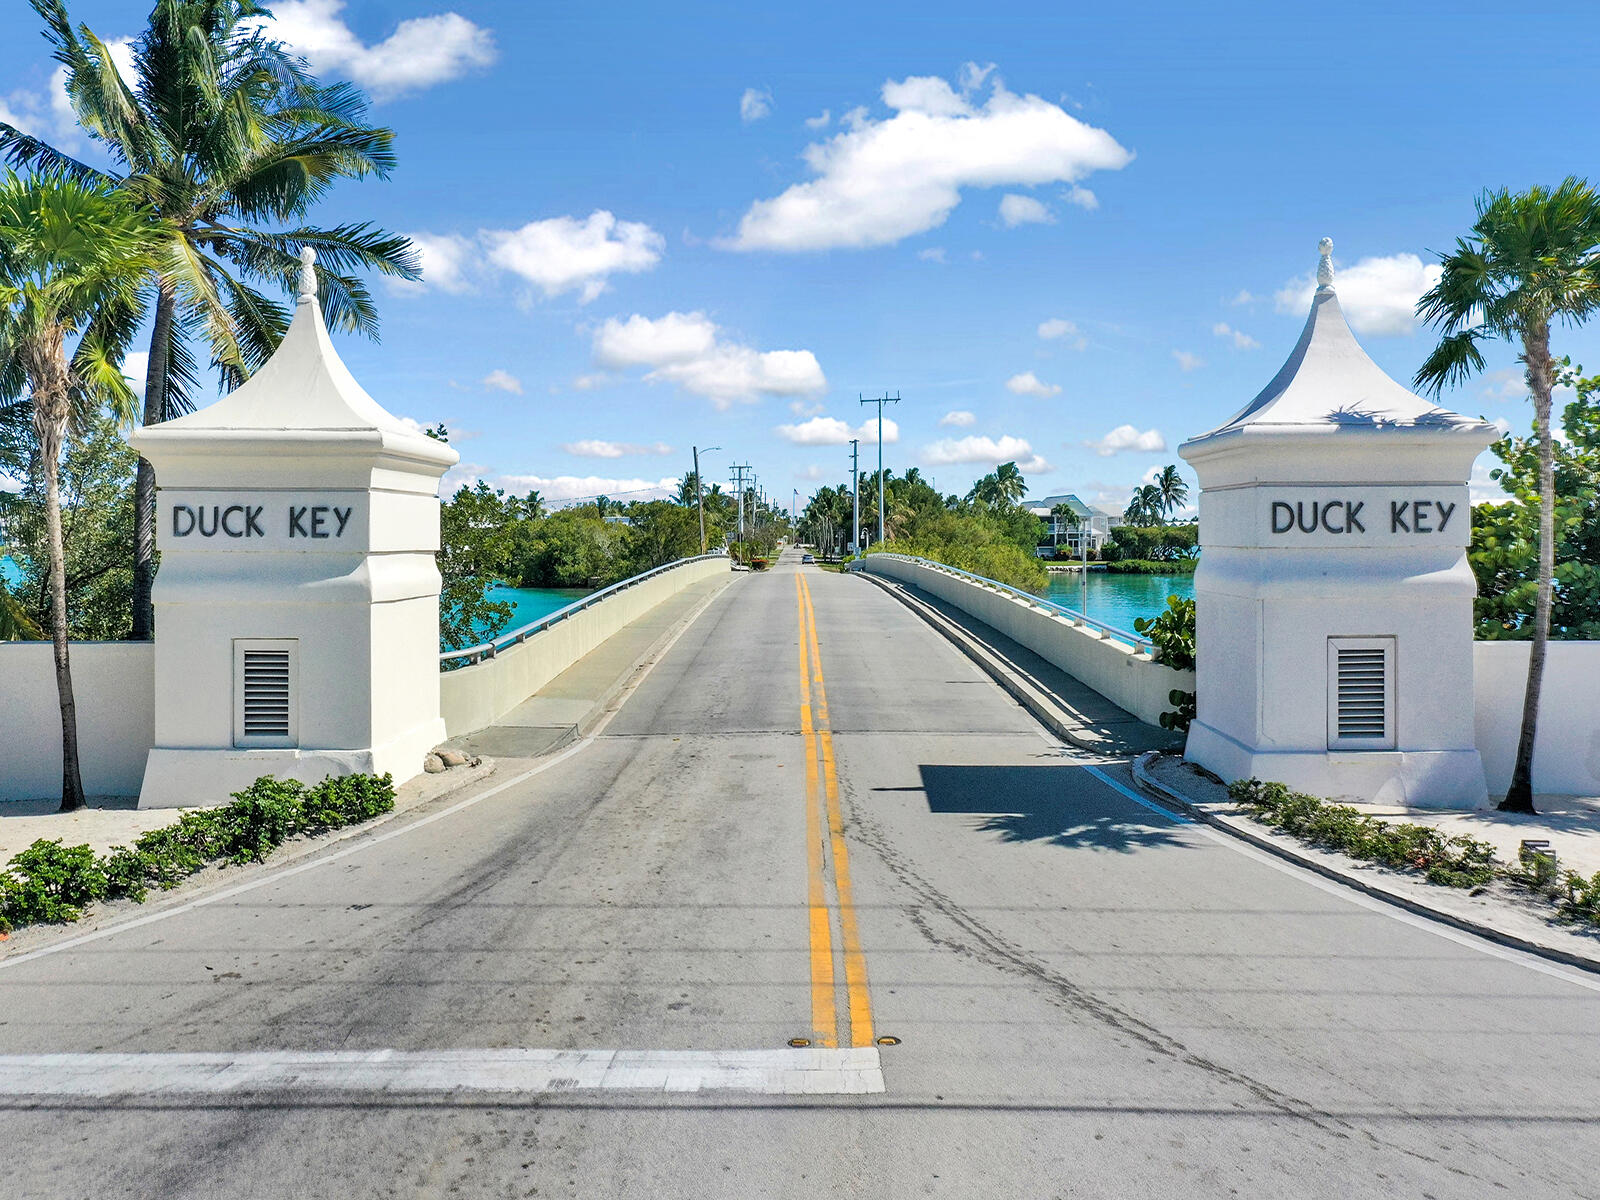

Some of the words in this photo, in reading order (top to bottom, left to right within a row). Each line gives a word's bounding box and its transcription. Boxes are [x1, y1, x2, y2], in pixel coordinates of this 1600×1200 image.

[173, 505, 264, 538] DUCK
[288, 506, 352, 538] KEY
[1271, 500, 1365, 534] DUCK
[1391, 501, 1456, 534] KEY
